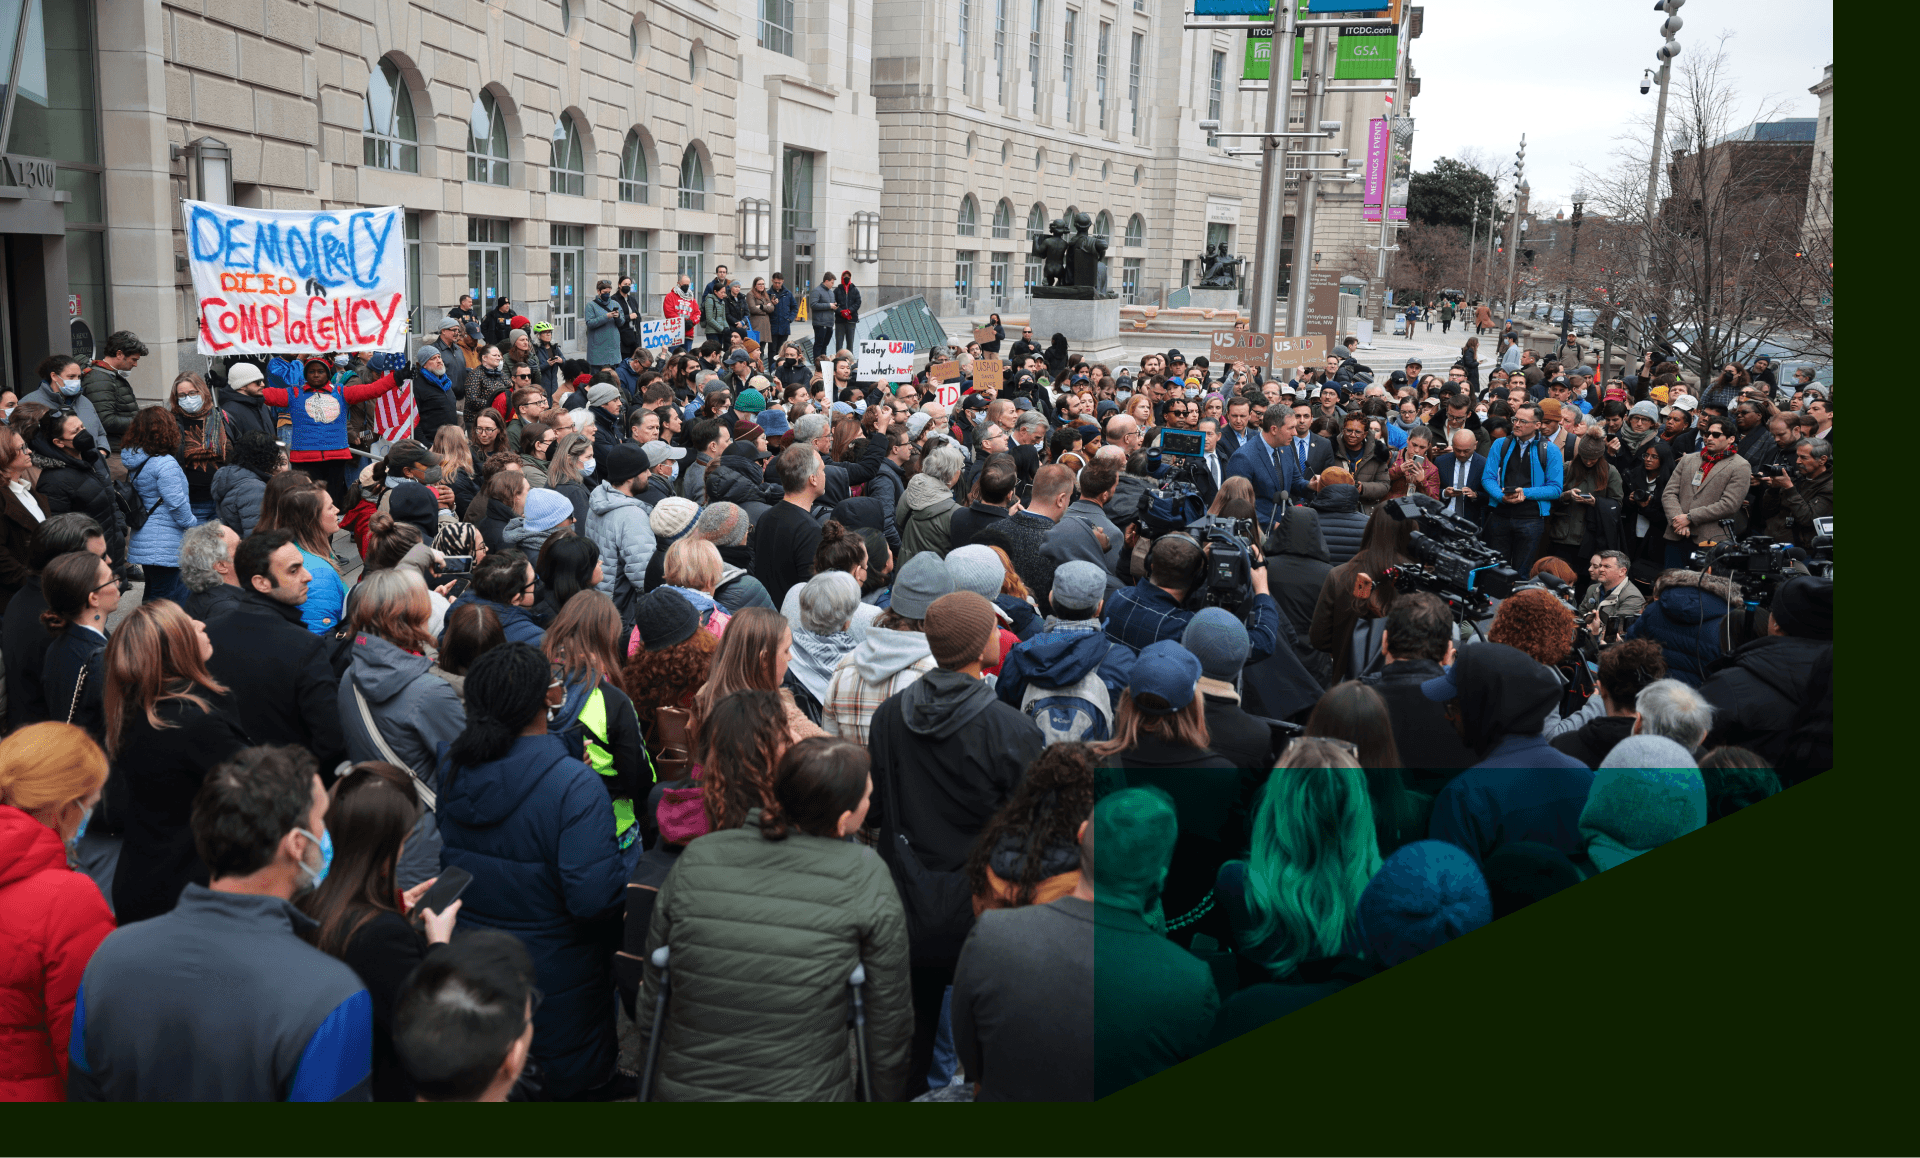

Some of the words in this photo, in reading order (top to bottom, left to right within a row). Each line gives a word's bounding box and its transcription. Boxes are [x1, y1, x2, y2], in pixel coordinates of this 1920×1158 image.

[1346, 26, 1392, 34] ITCDC.com
[1354, 46, 1378, 56] GSA
[1373, 121, 1382, 148] EVENTS
[18, 162, 54, 188] 1300
[1370, 158, 1380, 195] MEETINGS
[192, 206, 396, 289] DEMOCRACY
[220, 272, 297, 296] DIED
[1214, 332, 1266, 348] USAID
[1274, 338, 1314, 352] USAID
[860, 342, 886, 358] Today
[889, 342, 915, 354] USAID
[1214, 350, 1238, 360] Saves
[1244, 353, 1270, 362] Lives!
[871, 361, 895, 375] what's
[976, 362, 1000, 372] USAID
[1276, 356, 1298, 366] Saves
